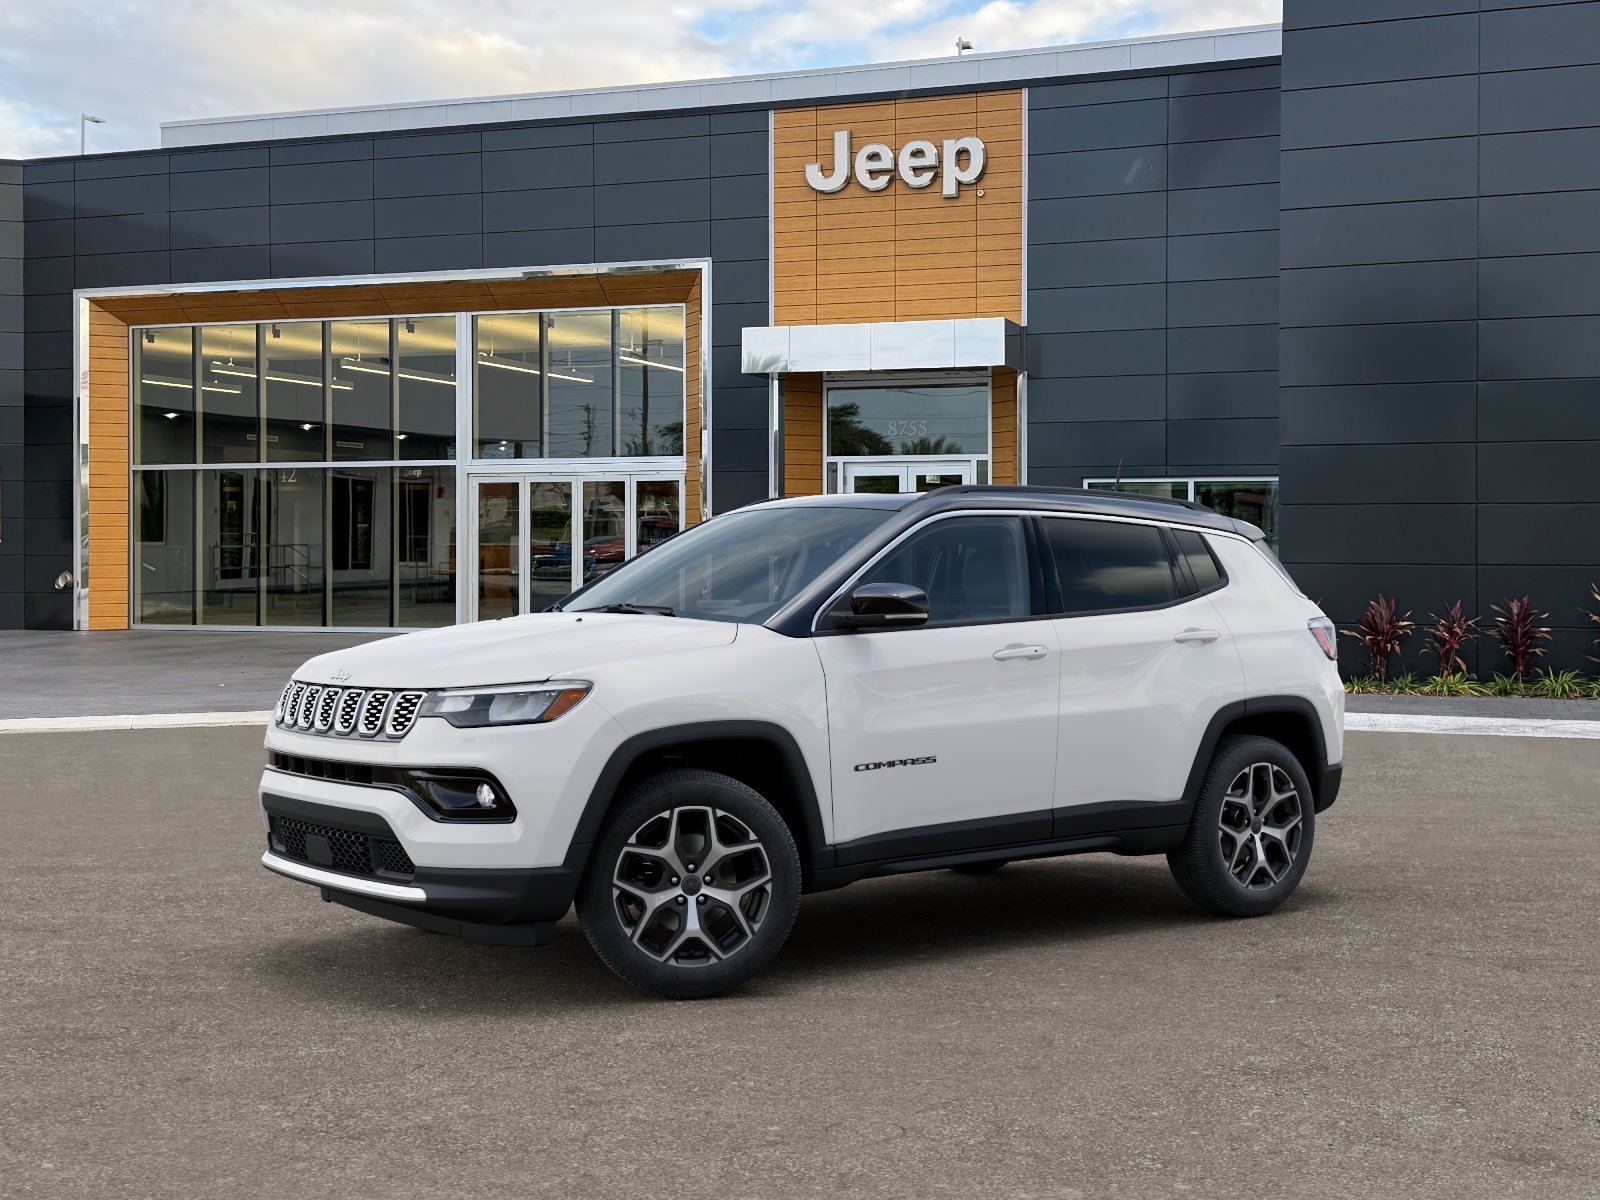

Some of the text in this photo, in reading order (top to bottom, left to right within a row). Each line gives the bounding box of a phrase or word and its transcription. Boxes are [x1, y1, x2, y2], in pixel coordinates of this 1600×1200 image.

[805, 129, 987, 198] Jeep
[888, 420, 928, 436] 8755
[854, 756, 937, 772] COMPASS
